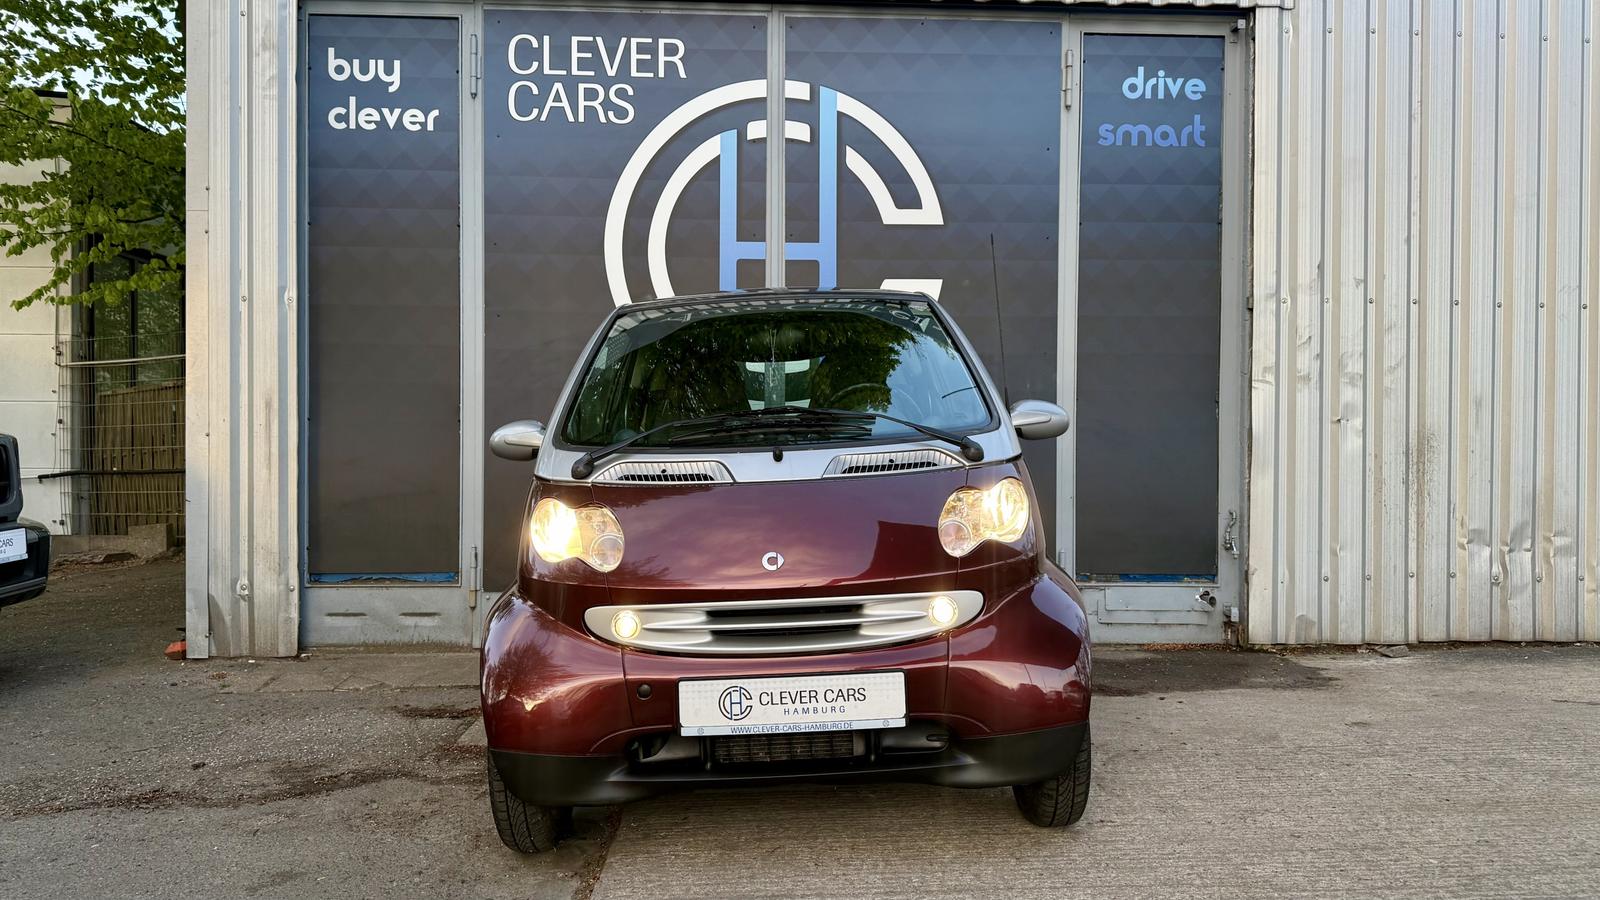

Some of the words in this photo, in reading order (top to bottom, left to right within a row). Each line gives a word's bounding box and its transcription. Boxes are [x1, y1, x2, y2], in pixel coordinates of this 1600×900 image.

[327, 47, 400, 93] buy
[507, 33, 688, 79] CLEVER
[1121, 66, 1207, 101] drive
[327, 96, 440, 132] clever
[507, 80, 635, 125] CARS
[1097, 114, 1206, 147] smart
[758, 689, 819, 706] CLEVER
[823, 687, 867, 703] CARS
[783, 705, 847, 716] HAMBURG
